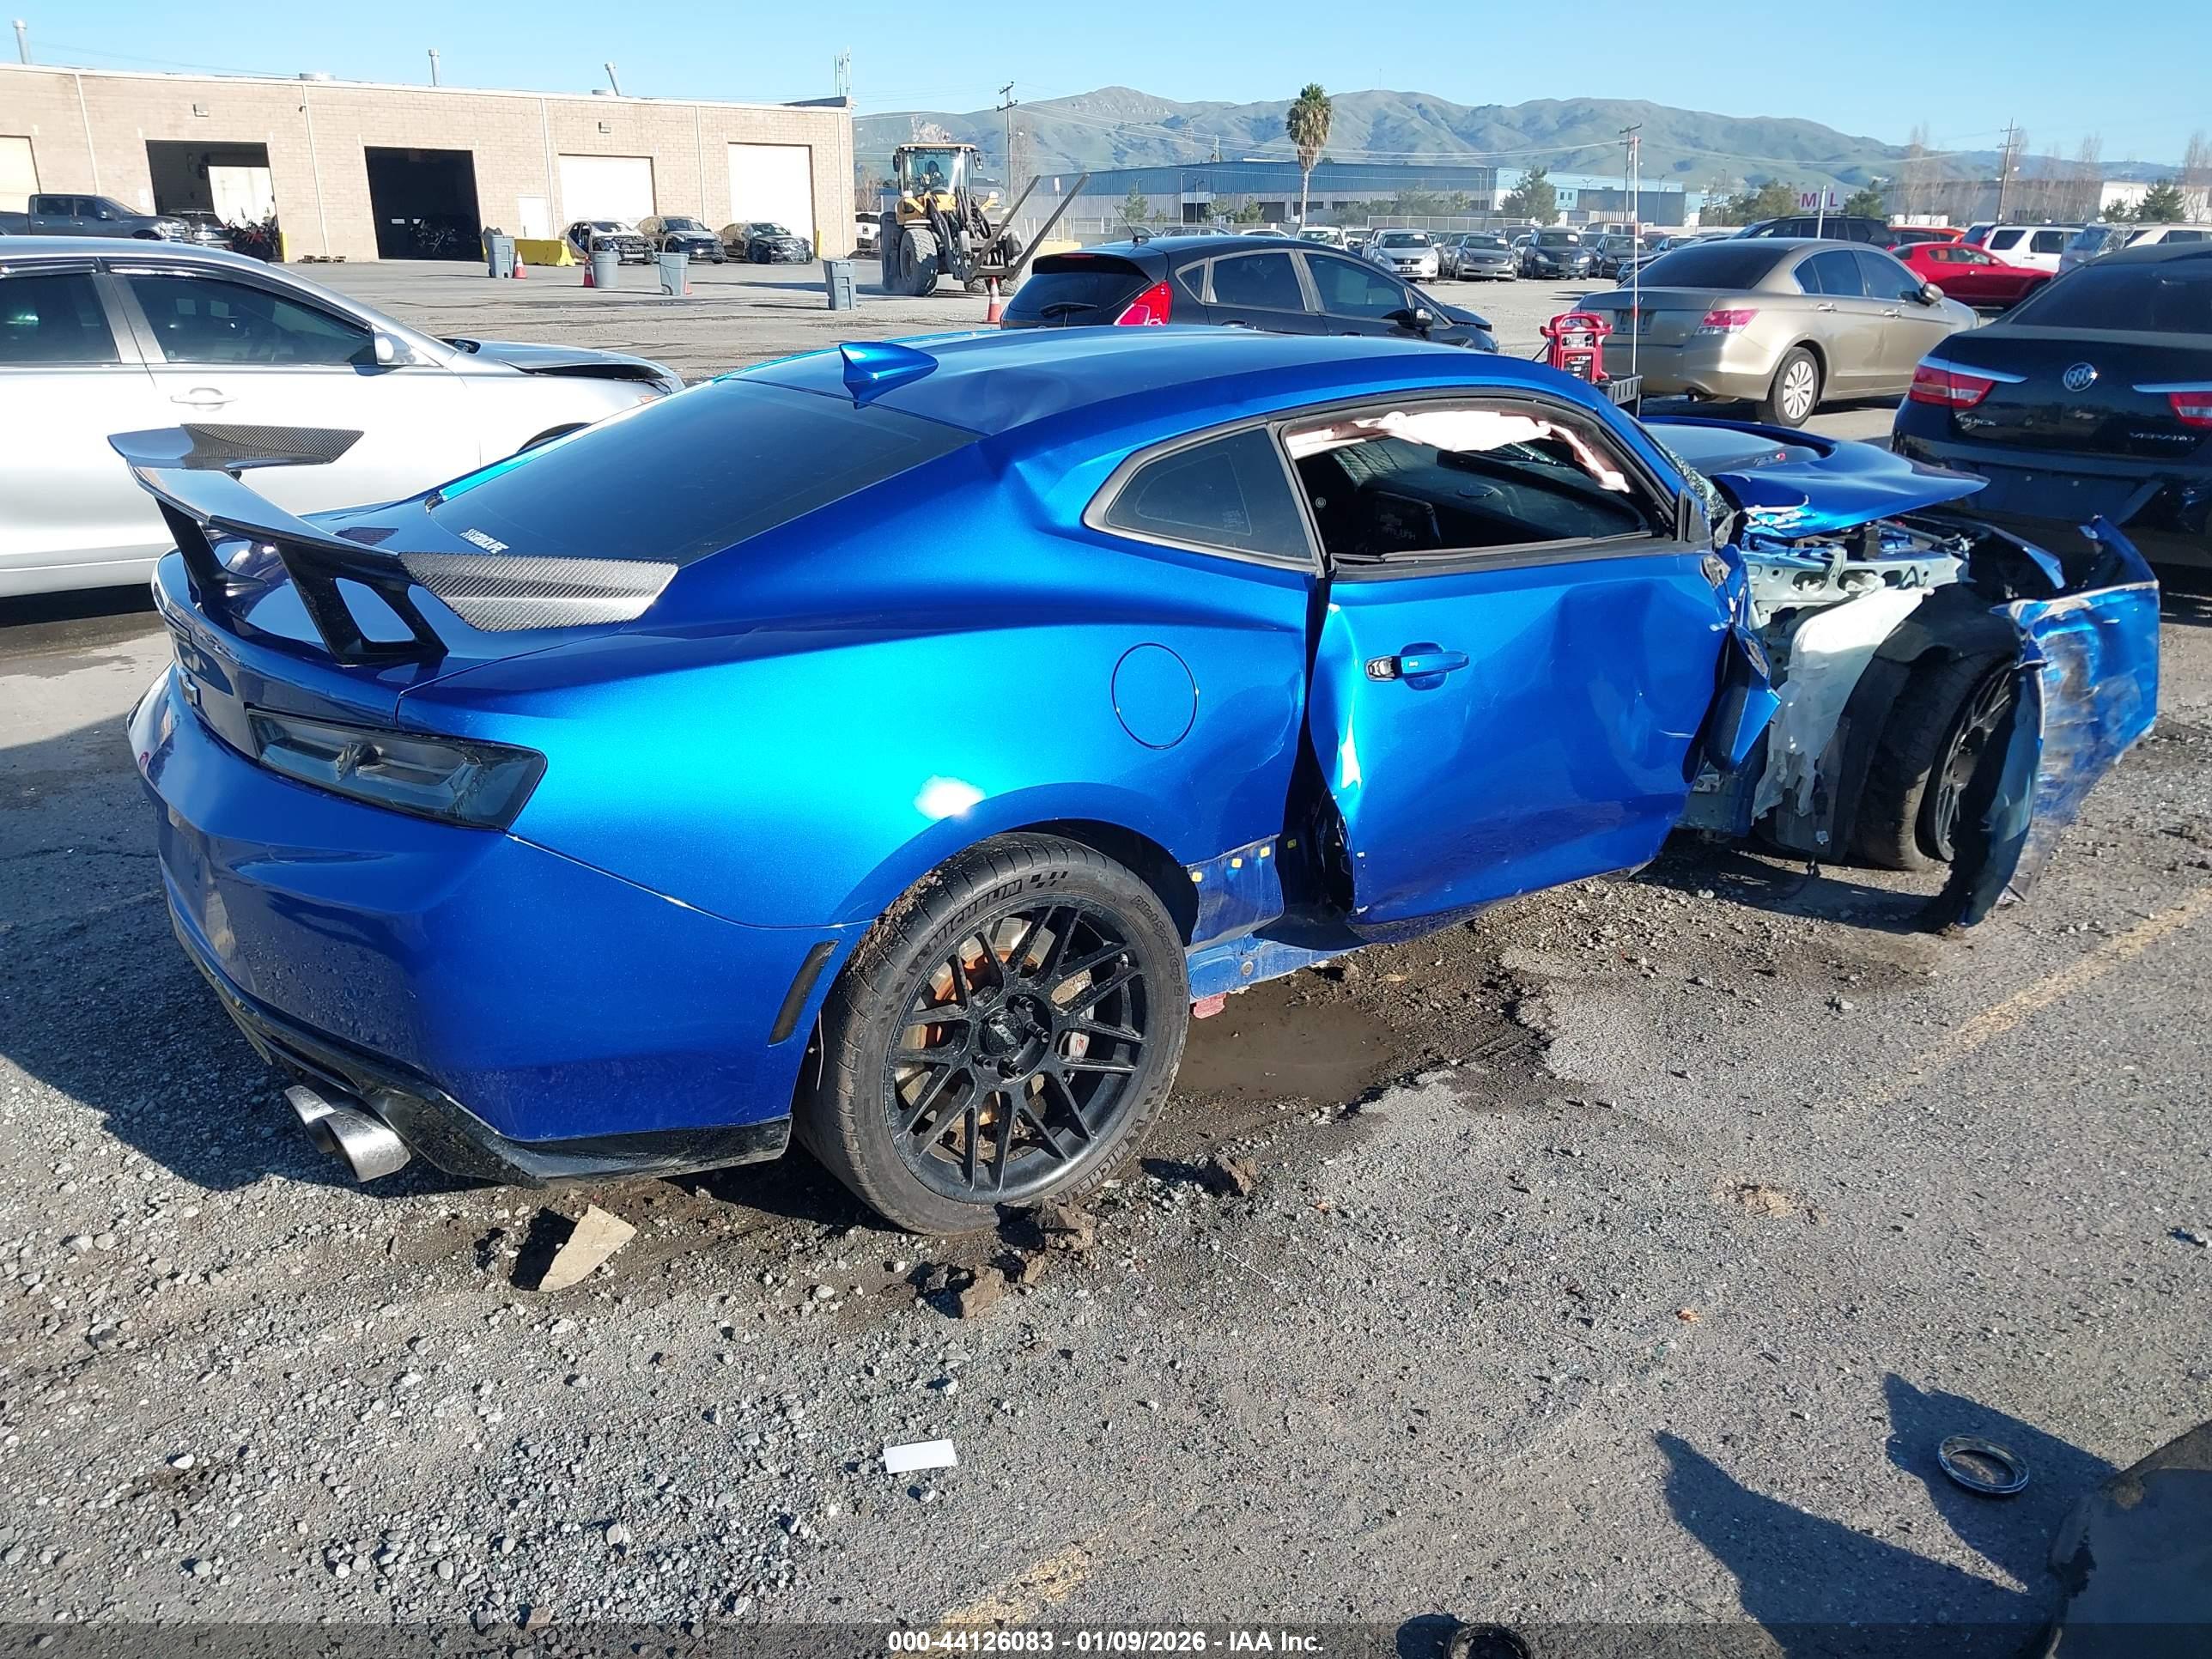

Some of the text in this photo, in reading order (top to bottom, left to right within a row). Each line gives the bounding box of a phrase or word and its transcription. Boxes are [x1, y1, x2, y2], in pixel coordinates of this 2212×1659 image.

[1801, 191, 1838, 207] M L
[928, 878, 1023, 951] MICHELIN
